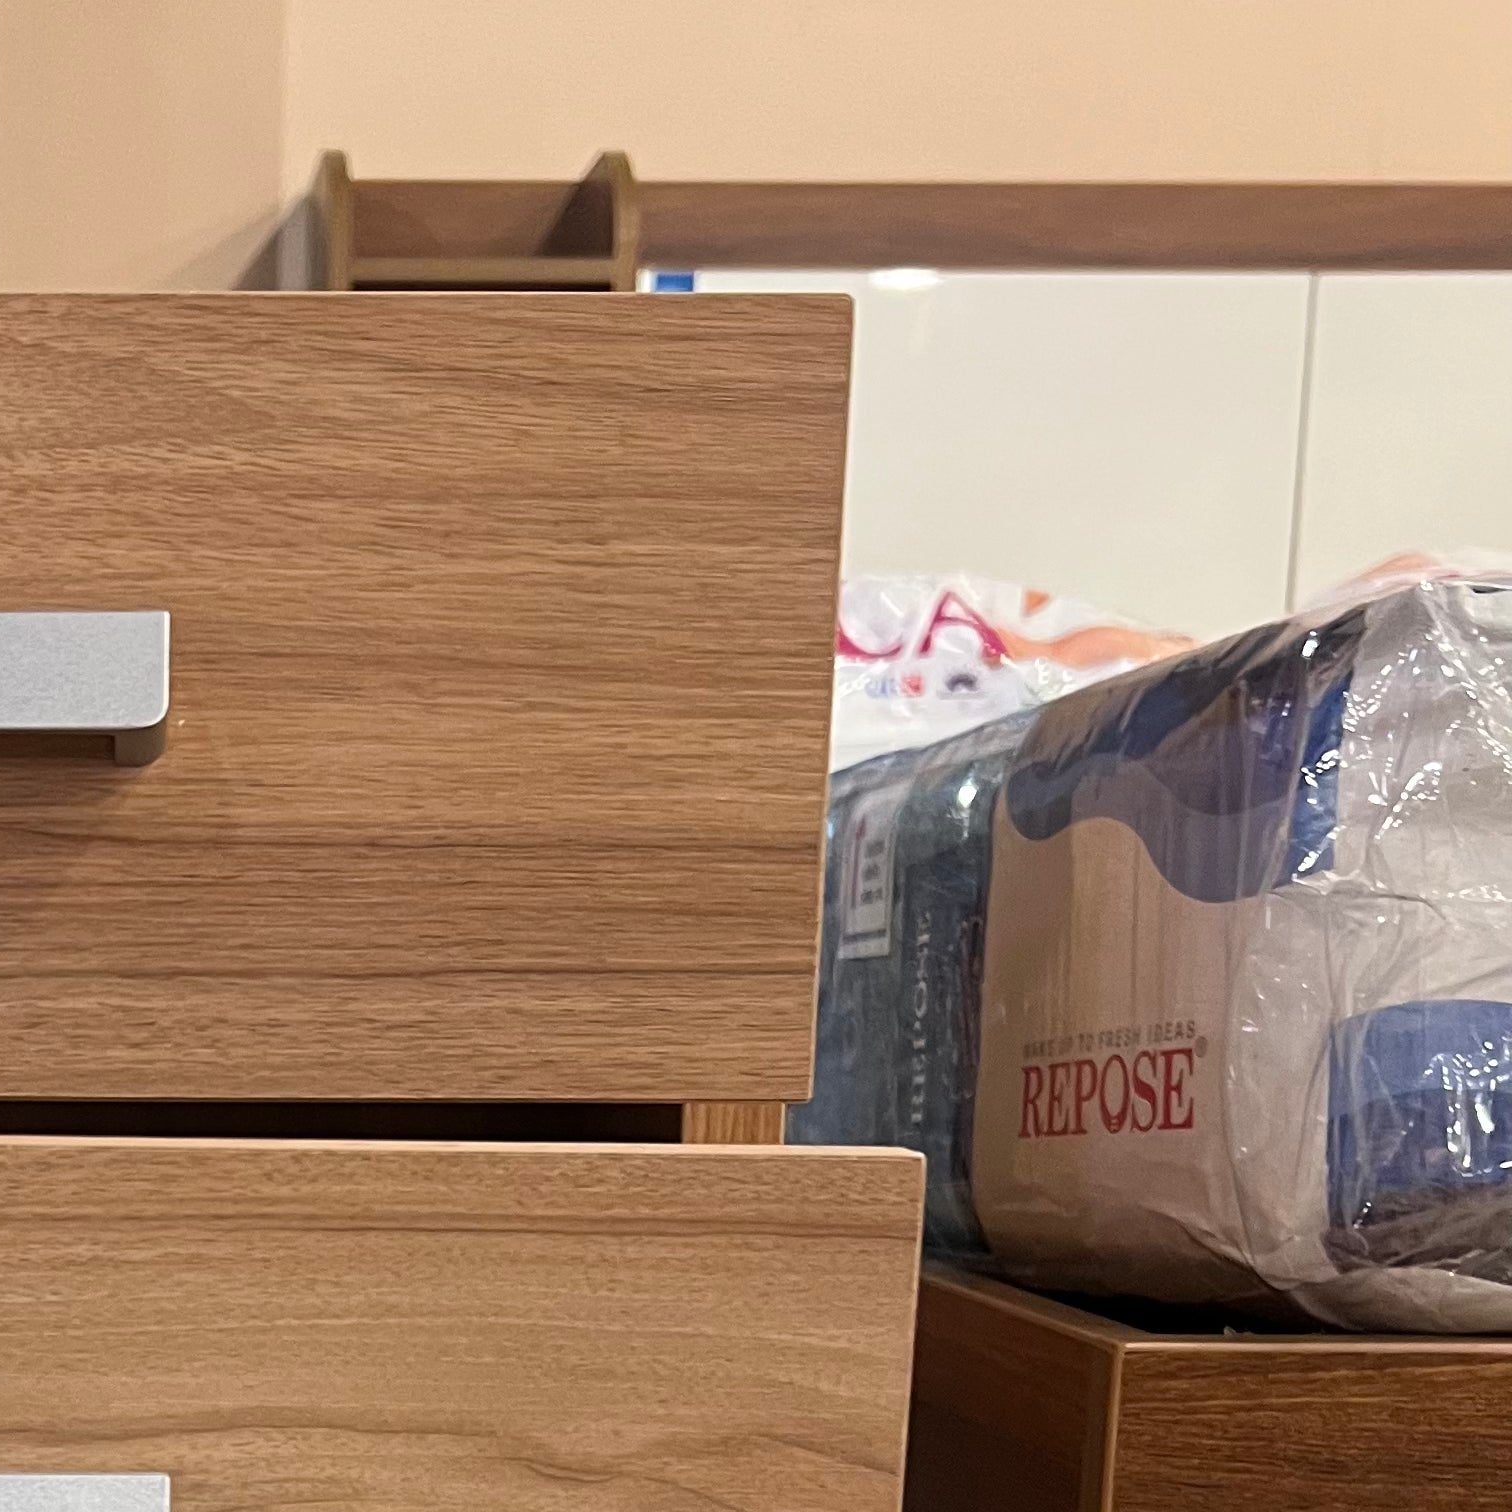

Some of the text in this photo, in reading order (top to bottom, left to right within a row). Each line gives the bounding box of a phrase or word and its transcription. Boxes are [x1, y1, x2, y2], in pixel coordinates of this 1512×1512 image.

[1097, 1026, 1142, 1049] FRESH
[1147, 1019, 1196, 1044] IDEAS
[1017, 1048, 1195, 1139] REPOSE
